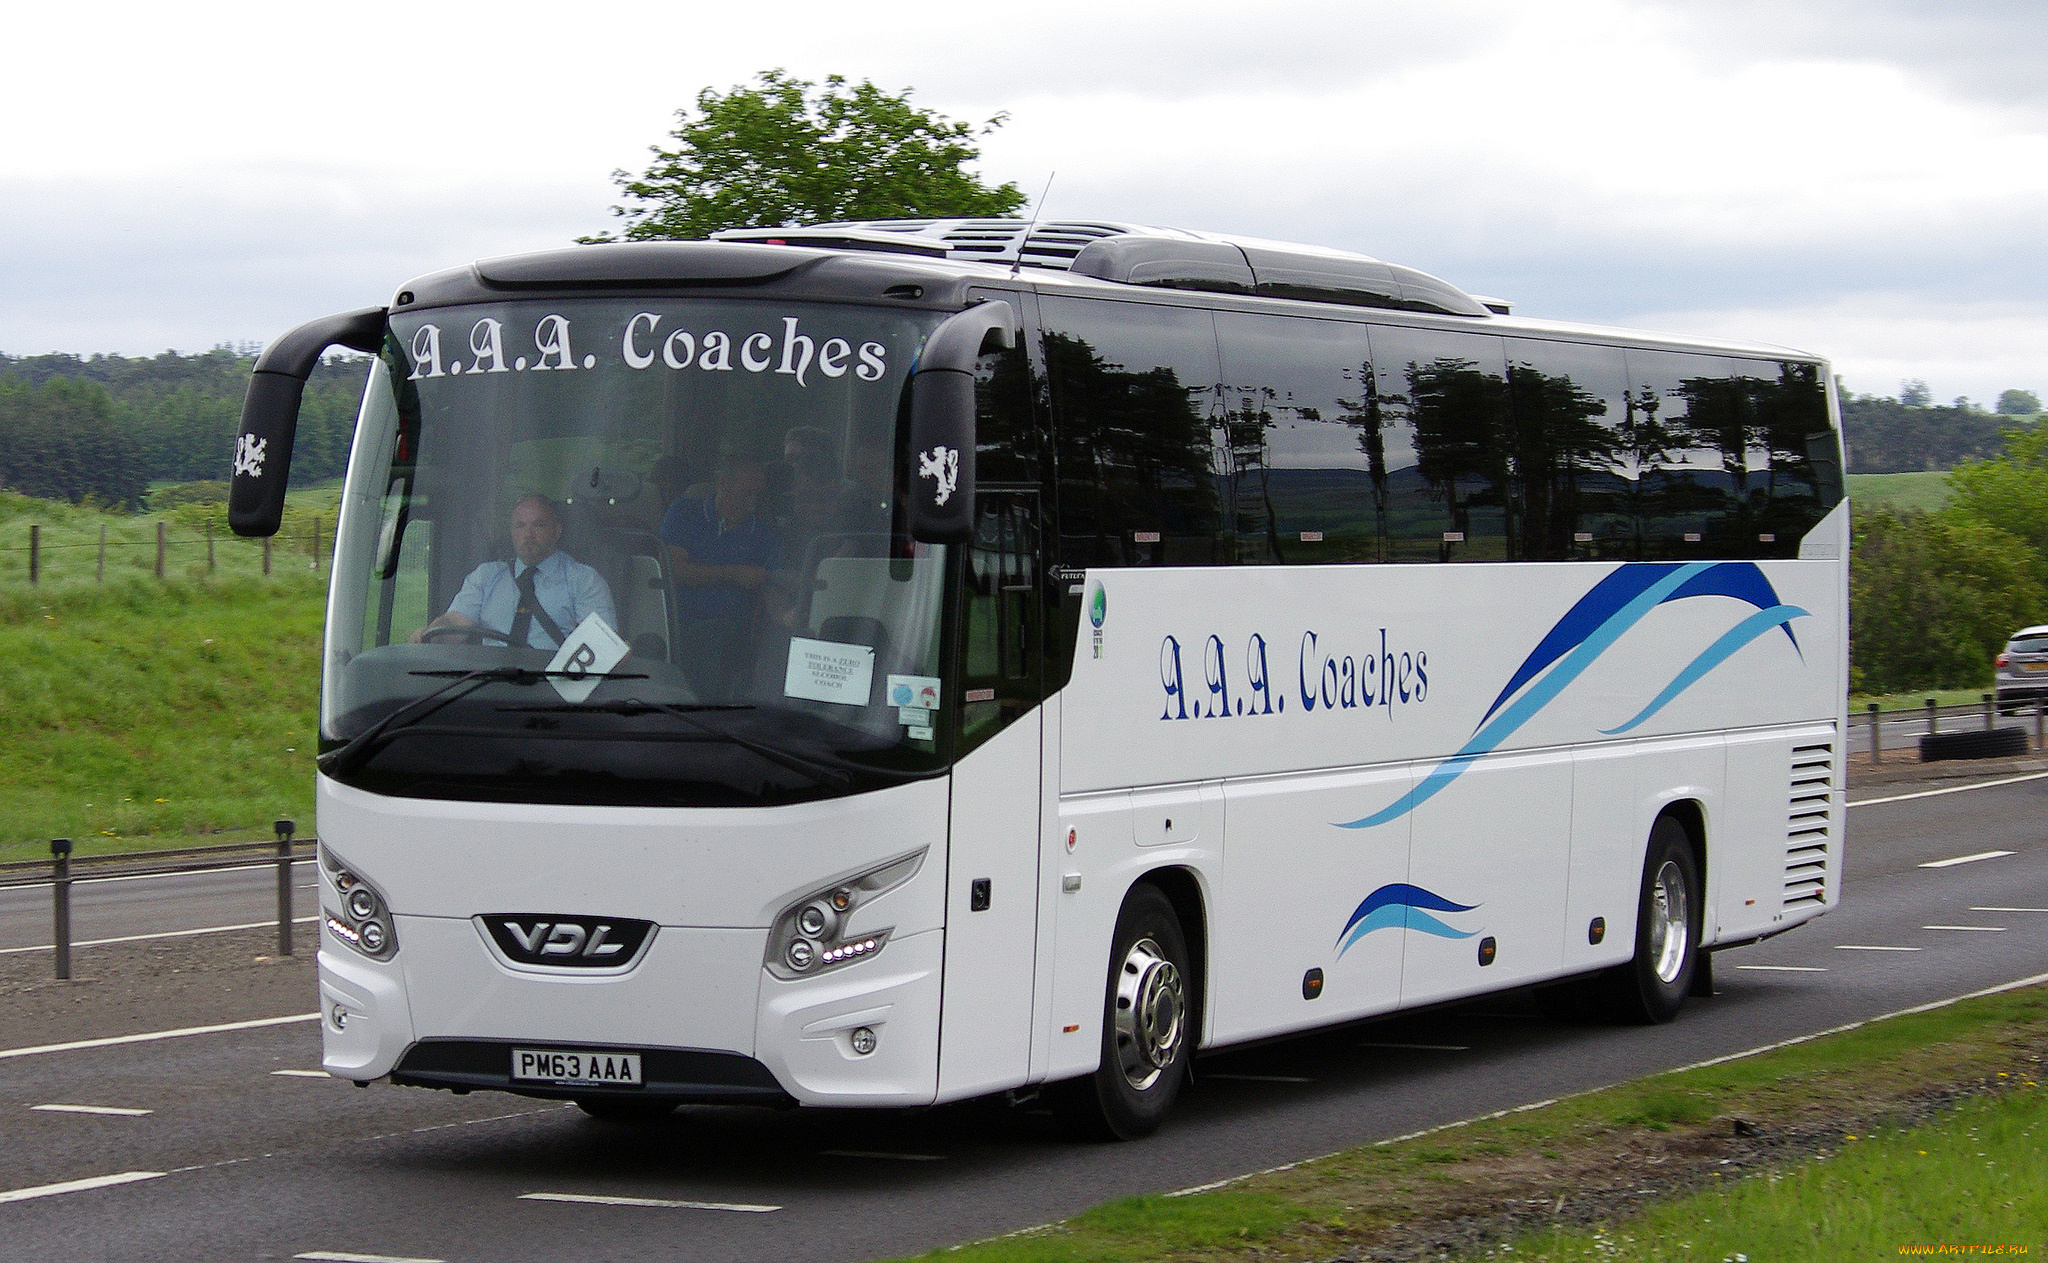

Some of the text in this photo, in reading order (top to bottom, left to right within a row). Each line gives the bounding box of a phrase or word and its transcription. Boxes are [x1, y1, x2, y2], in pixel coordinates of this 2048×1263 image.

[407, 312, 887, 388] A.A.A. Coaches
[1160, 627, 1428, 723] A.A.A. Coaches
[503, 922, 625, 957] VDL
[521, 1053, 632, 1081] PM63 AAA
